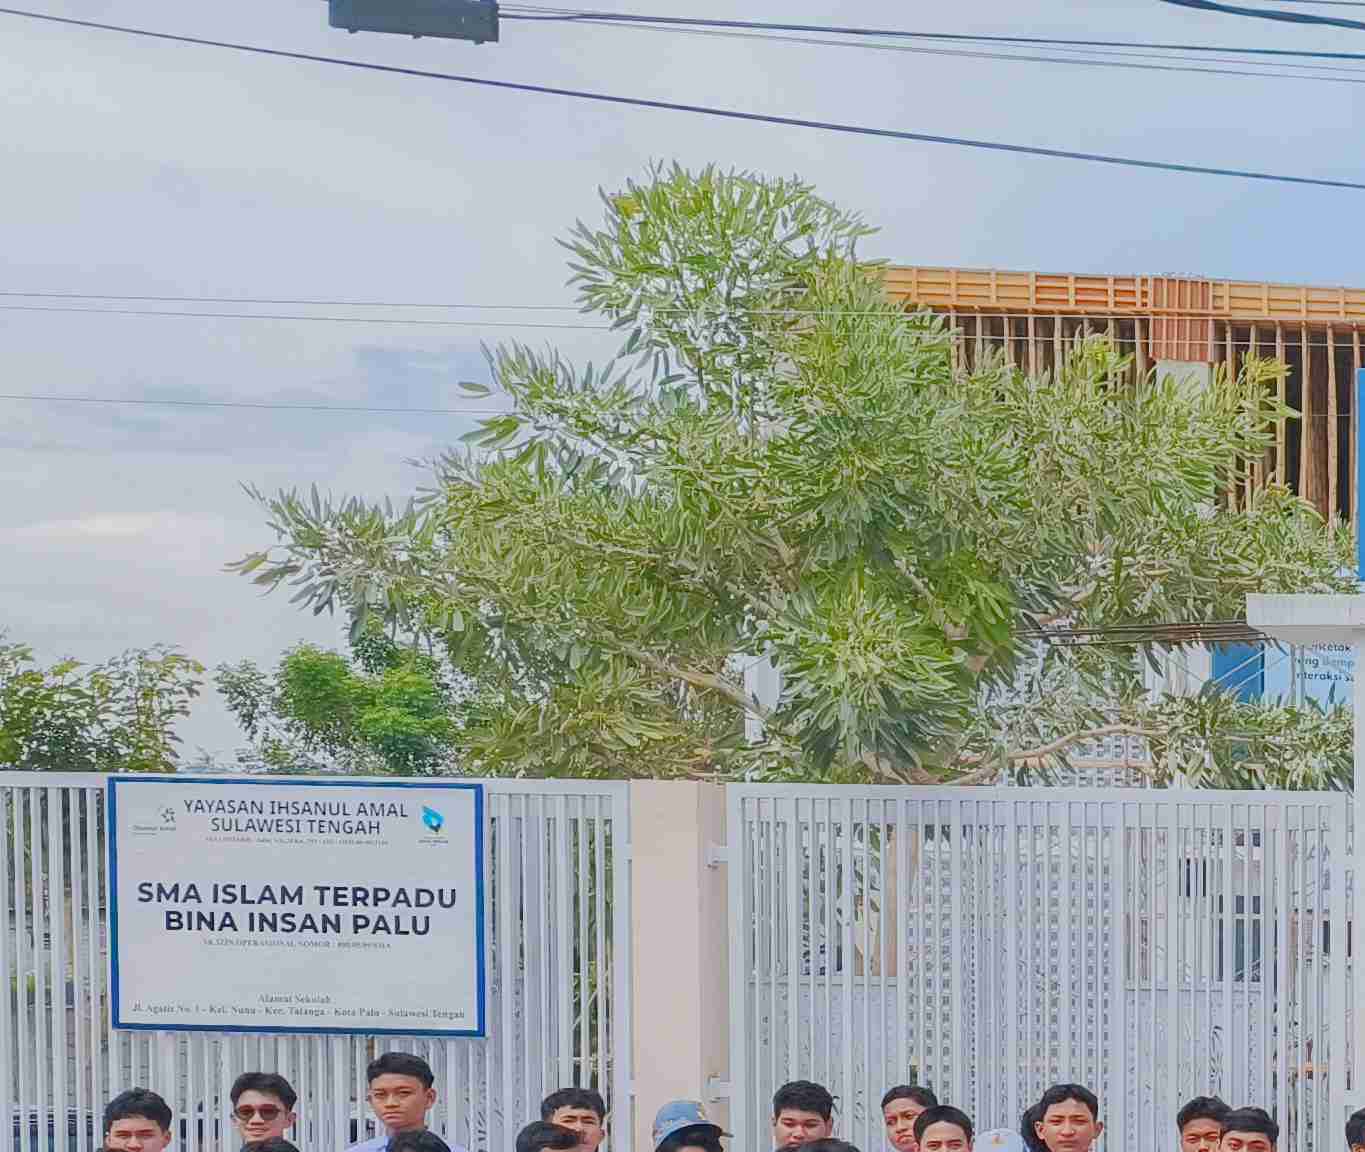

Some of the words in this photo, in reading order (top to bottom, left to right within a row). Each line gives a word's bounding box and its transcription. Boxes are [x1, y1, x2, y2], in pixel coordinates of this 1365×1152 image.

[183, 799, 264, 815] YAYASAN
[269, 800, 352, 816] IHSANUL
[356, 802, 409, 818] AMAL
[211, 817, 301, 833] SULAWESI
[307, 819, 380, 835] TENGAH
[137, 881, 203, 904] SMA
[212, 883, 304, 906] ISLAM
[313, 885, 457, 909] TERPADU
[165, 910, 239, 932] BINA
[248, 911, 341, 934] INSAN
[352, 914, 430, 936] PALU
